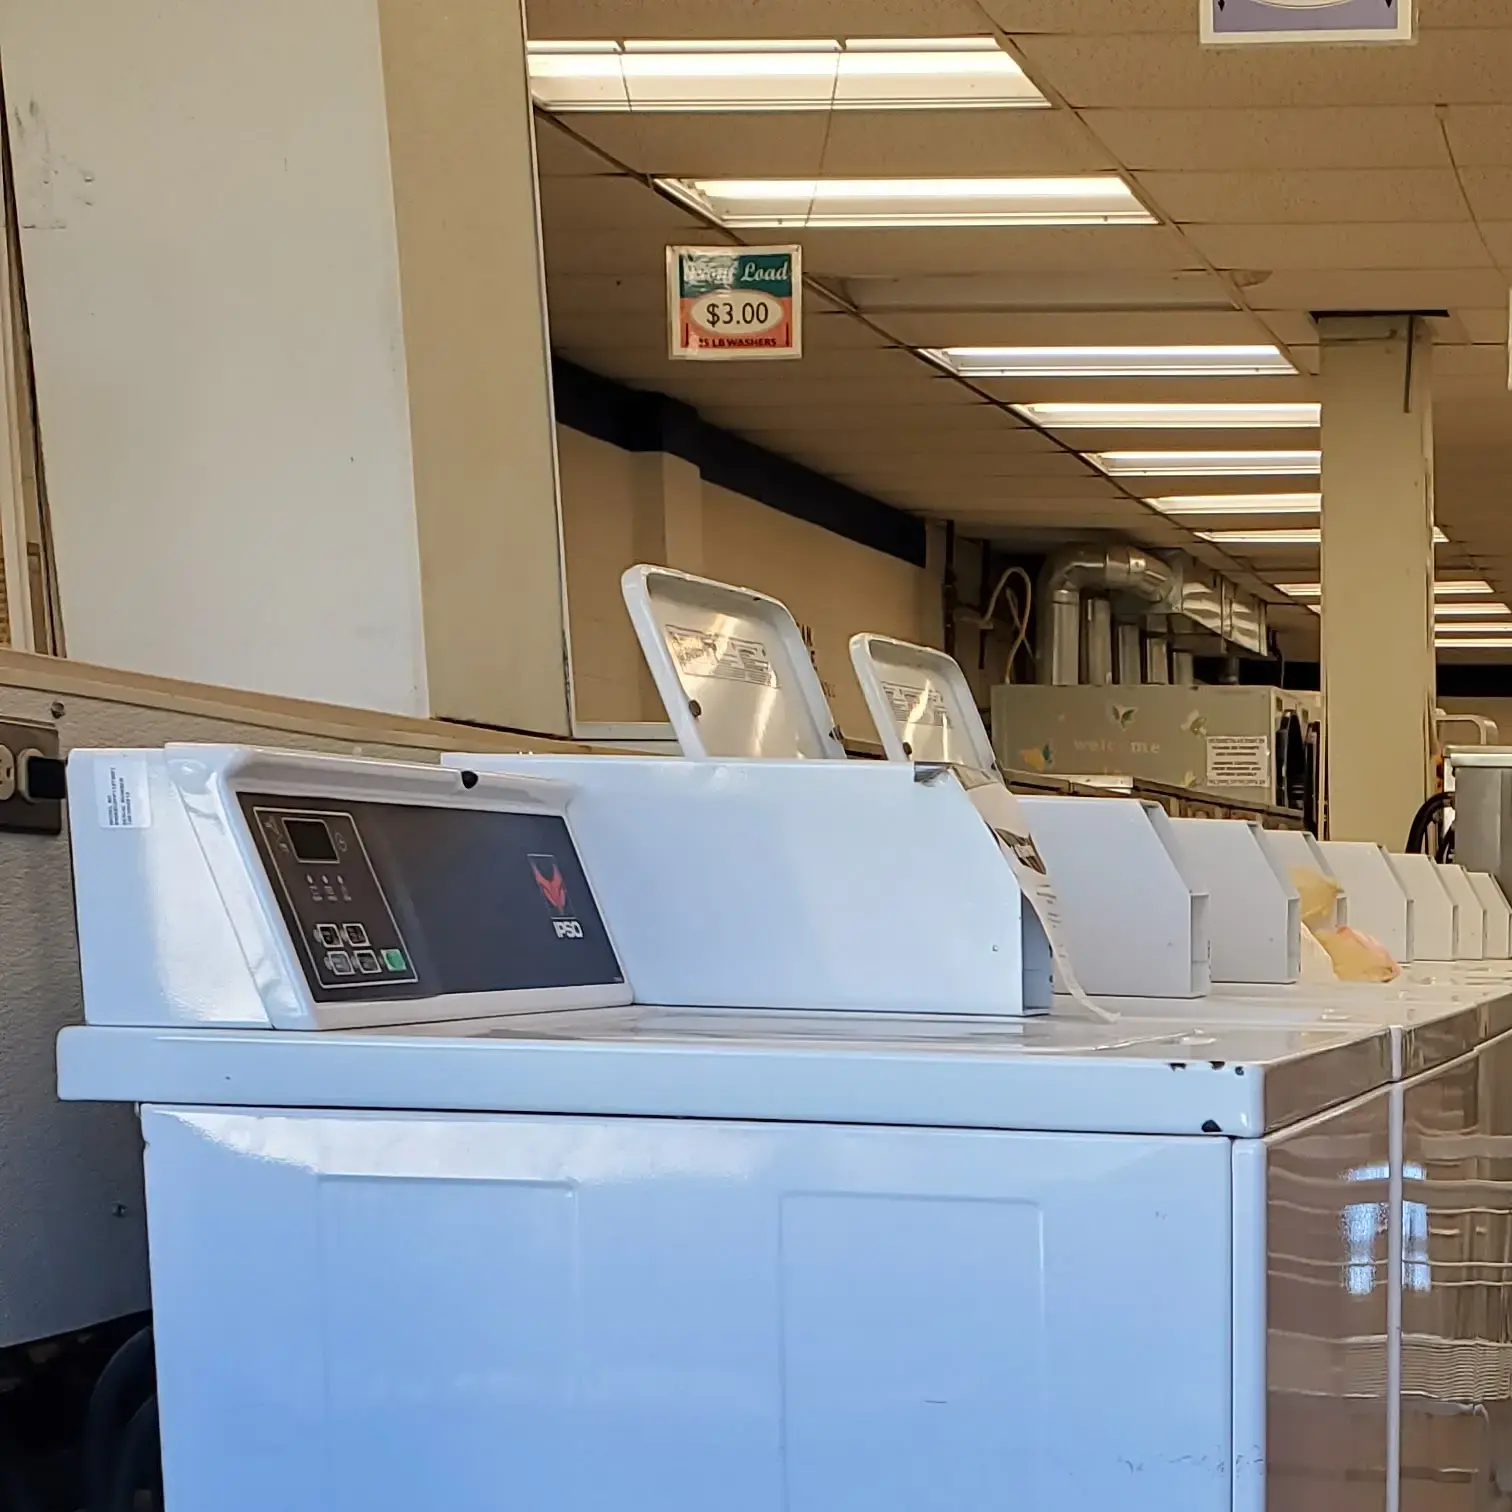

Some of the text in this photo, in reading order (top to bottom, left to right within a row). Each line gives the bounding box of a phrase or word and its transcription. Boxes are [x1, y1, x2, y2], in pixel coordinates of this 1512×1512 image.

[741, 261, 789, 282] Load
[706, 302, 769, 328] $3.00
[726, 338, 777, 347] WASHERS
[552, 920, 584, 938] IPSO
